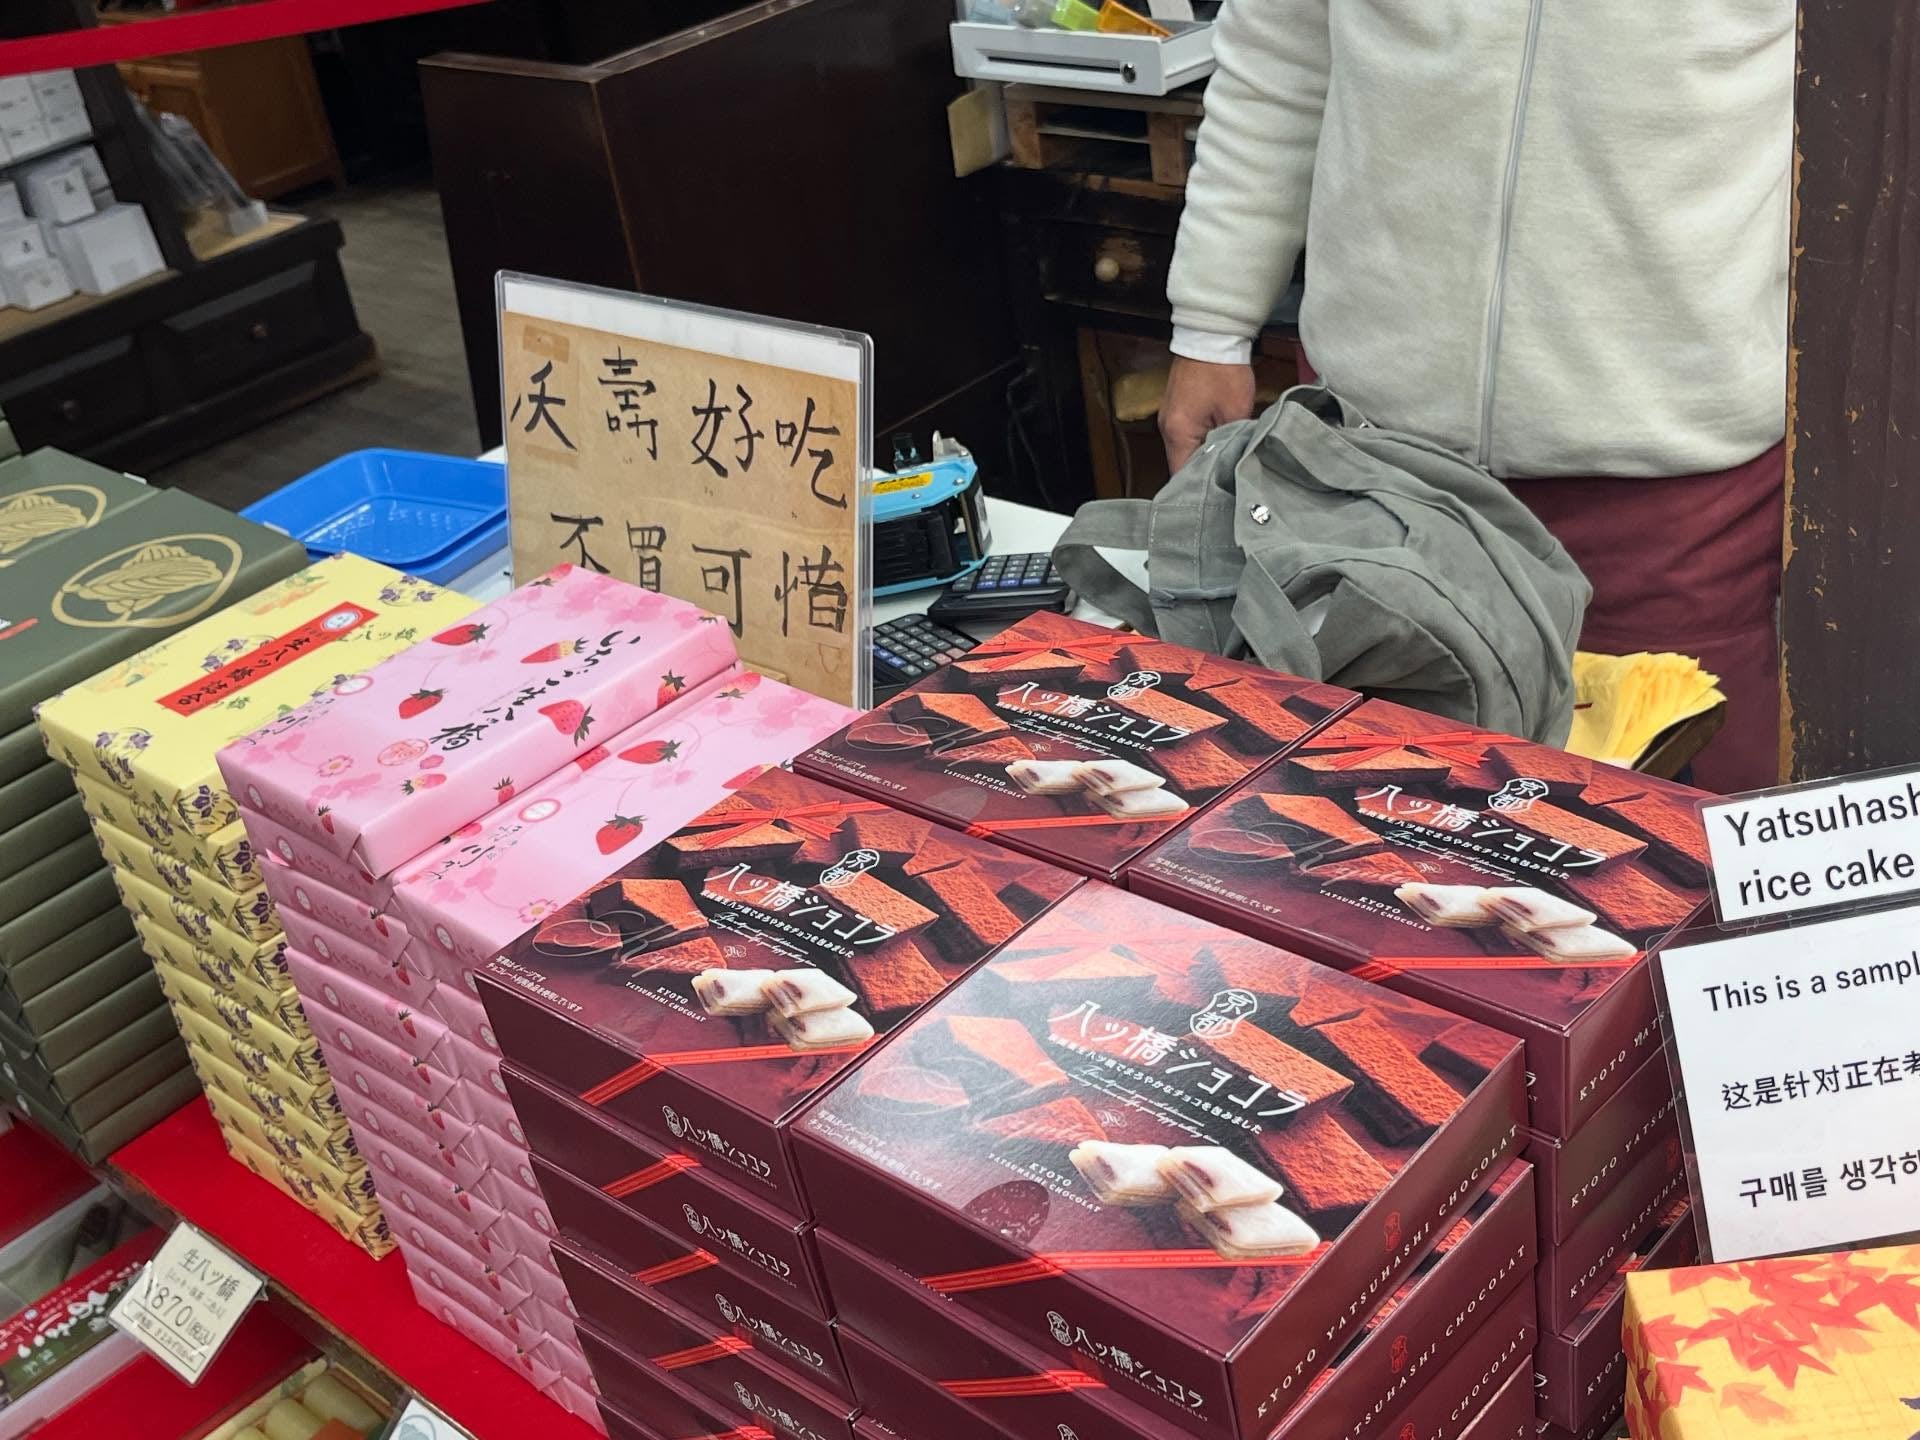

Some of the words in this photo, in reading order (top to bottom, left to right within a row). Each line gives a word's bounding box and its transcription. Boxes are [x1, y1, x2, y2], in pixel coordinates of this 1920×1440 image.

[943, 768, 988, 787] YATSUHASHI
[988, 783, 1028, 799] CHOCOLAT
[974, 772, 1006, 787] KYOTO
[1739, 868, 1811, 906] rice
[1825, 848, 1915, 891] cake
[1319, 889, 1377, 913] YATSUHASHI
[1380, 910, 1433, 932] CHOCOLAT
[1359, 896, 1401, 914] KYOTO
[626, 981, 667, 1005] YATSUHASHI
[666, 1002, 707, 1023] CHOCOLAT
[657, 986, 689, 1005] KYOTO
[1703, 981, 1767, 1011] This
[1775, 975, 1801, 1000] is
[1810, 974, 1826, 994] a
[1836, 951, 1920, 989] sampl
[1195, 990, 1254, 1035] 京都
[1579, 1051, 1626, 1101] KYOTO
[988, 1153, 1047, 1187] YATSUHASHI
[1049, 1184, 1102, 1214] CHOCOLAT
[1028, 1161, 1072, 1187] KYOTO
[1571, 1156, 1617, 1209] KYOTO
[1739, 1167, 1828, 1208] 구매를
[1257, 1348, 1316, 1418] KYOTO
[1326, 1221, 1431, 1340] YATSUHASHI
[1439, 1124, 1518, 1216] CHOCOLAT
[1570, 1247, 1614, 1298] KYOTO
[1344, 1343, 1436, 1440] TSUHASHI
[1445, 1245, 1526, 1337] CHOCOLAT
[1451, 1328, 1527, 1421] CHOCOLAT
